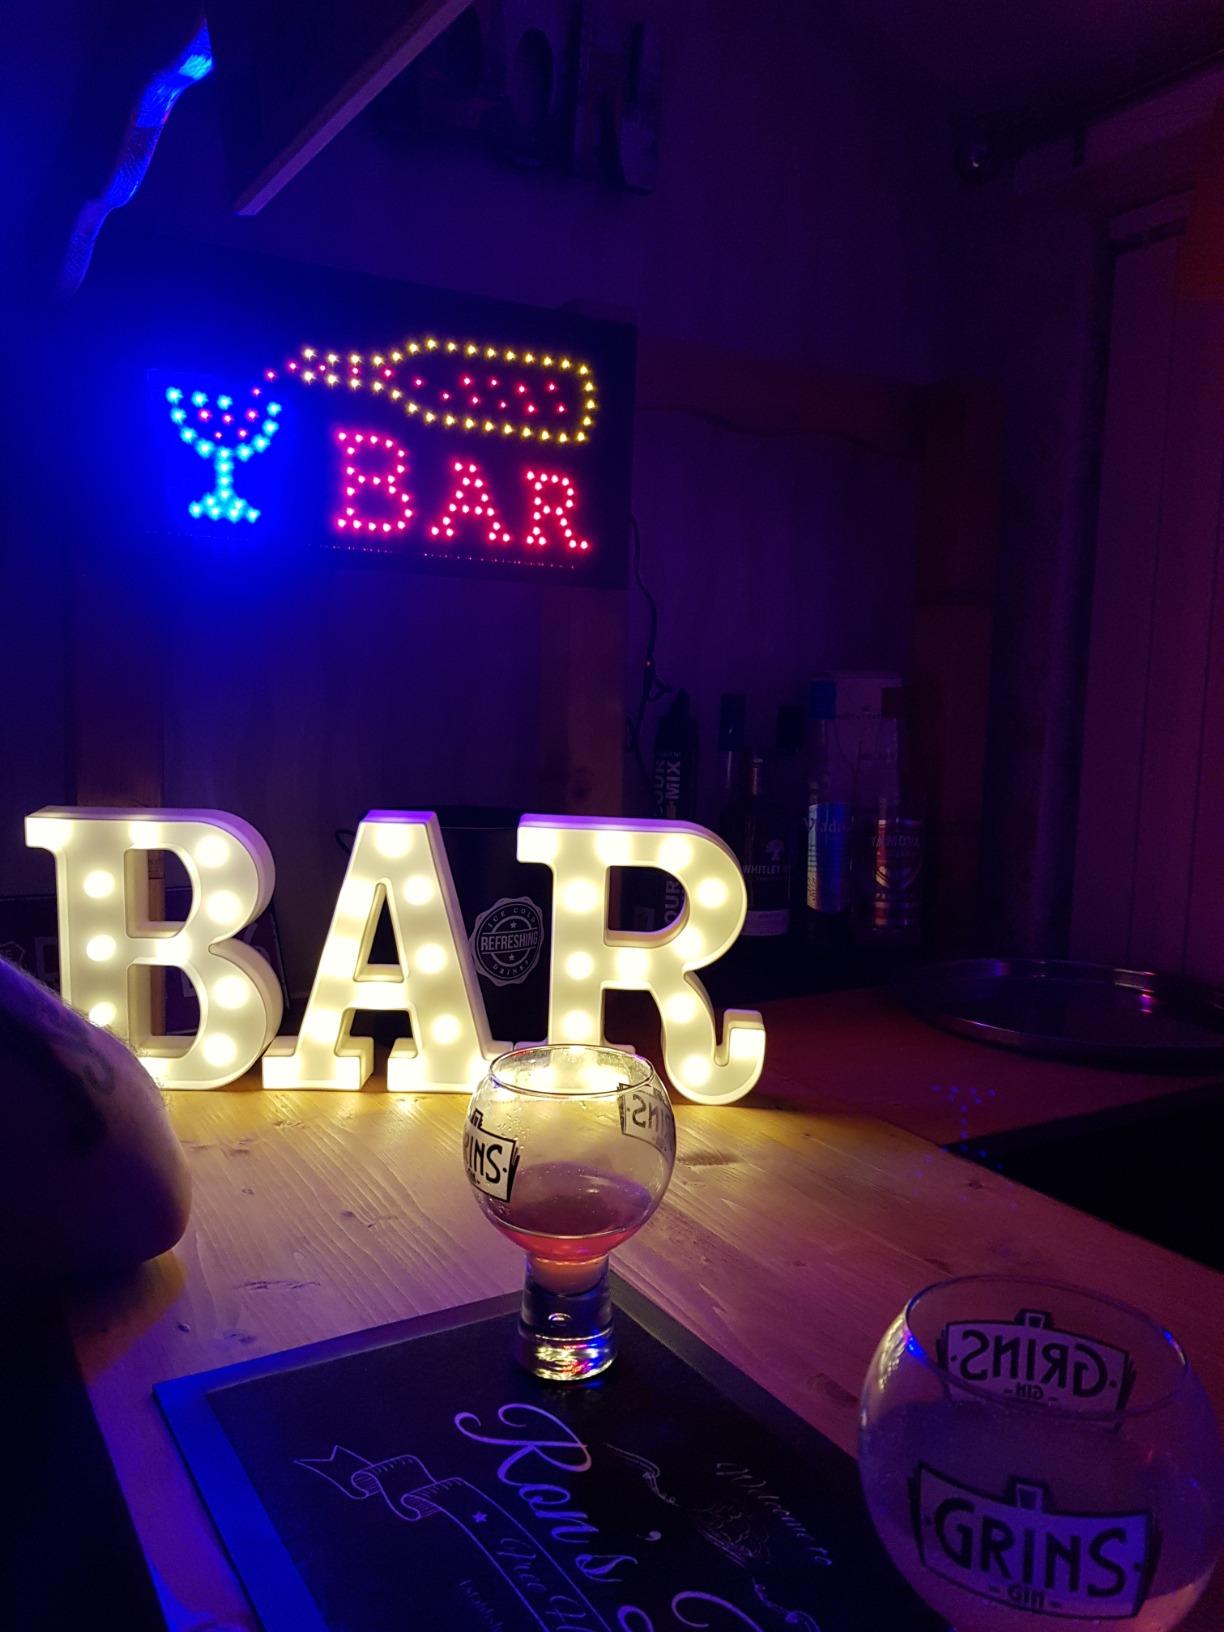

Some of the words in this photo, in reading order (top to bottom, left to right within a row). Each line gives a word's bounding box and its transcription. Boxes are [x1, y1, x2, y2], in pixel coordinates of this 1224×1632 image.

[334, 428, 593, 550] BAR
[665, 760, 681, 800] MIX
[25, 804, 766, 1105] BAR
[480, 931, 539, 951] REFRESHING
[487, 910, 506, 929] ICE
[453, 1402, 664, 1584] Ron's
[934, 1497, 1128, 1599] GRINS
[1007, 1583, 1046, 1610] GIN
